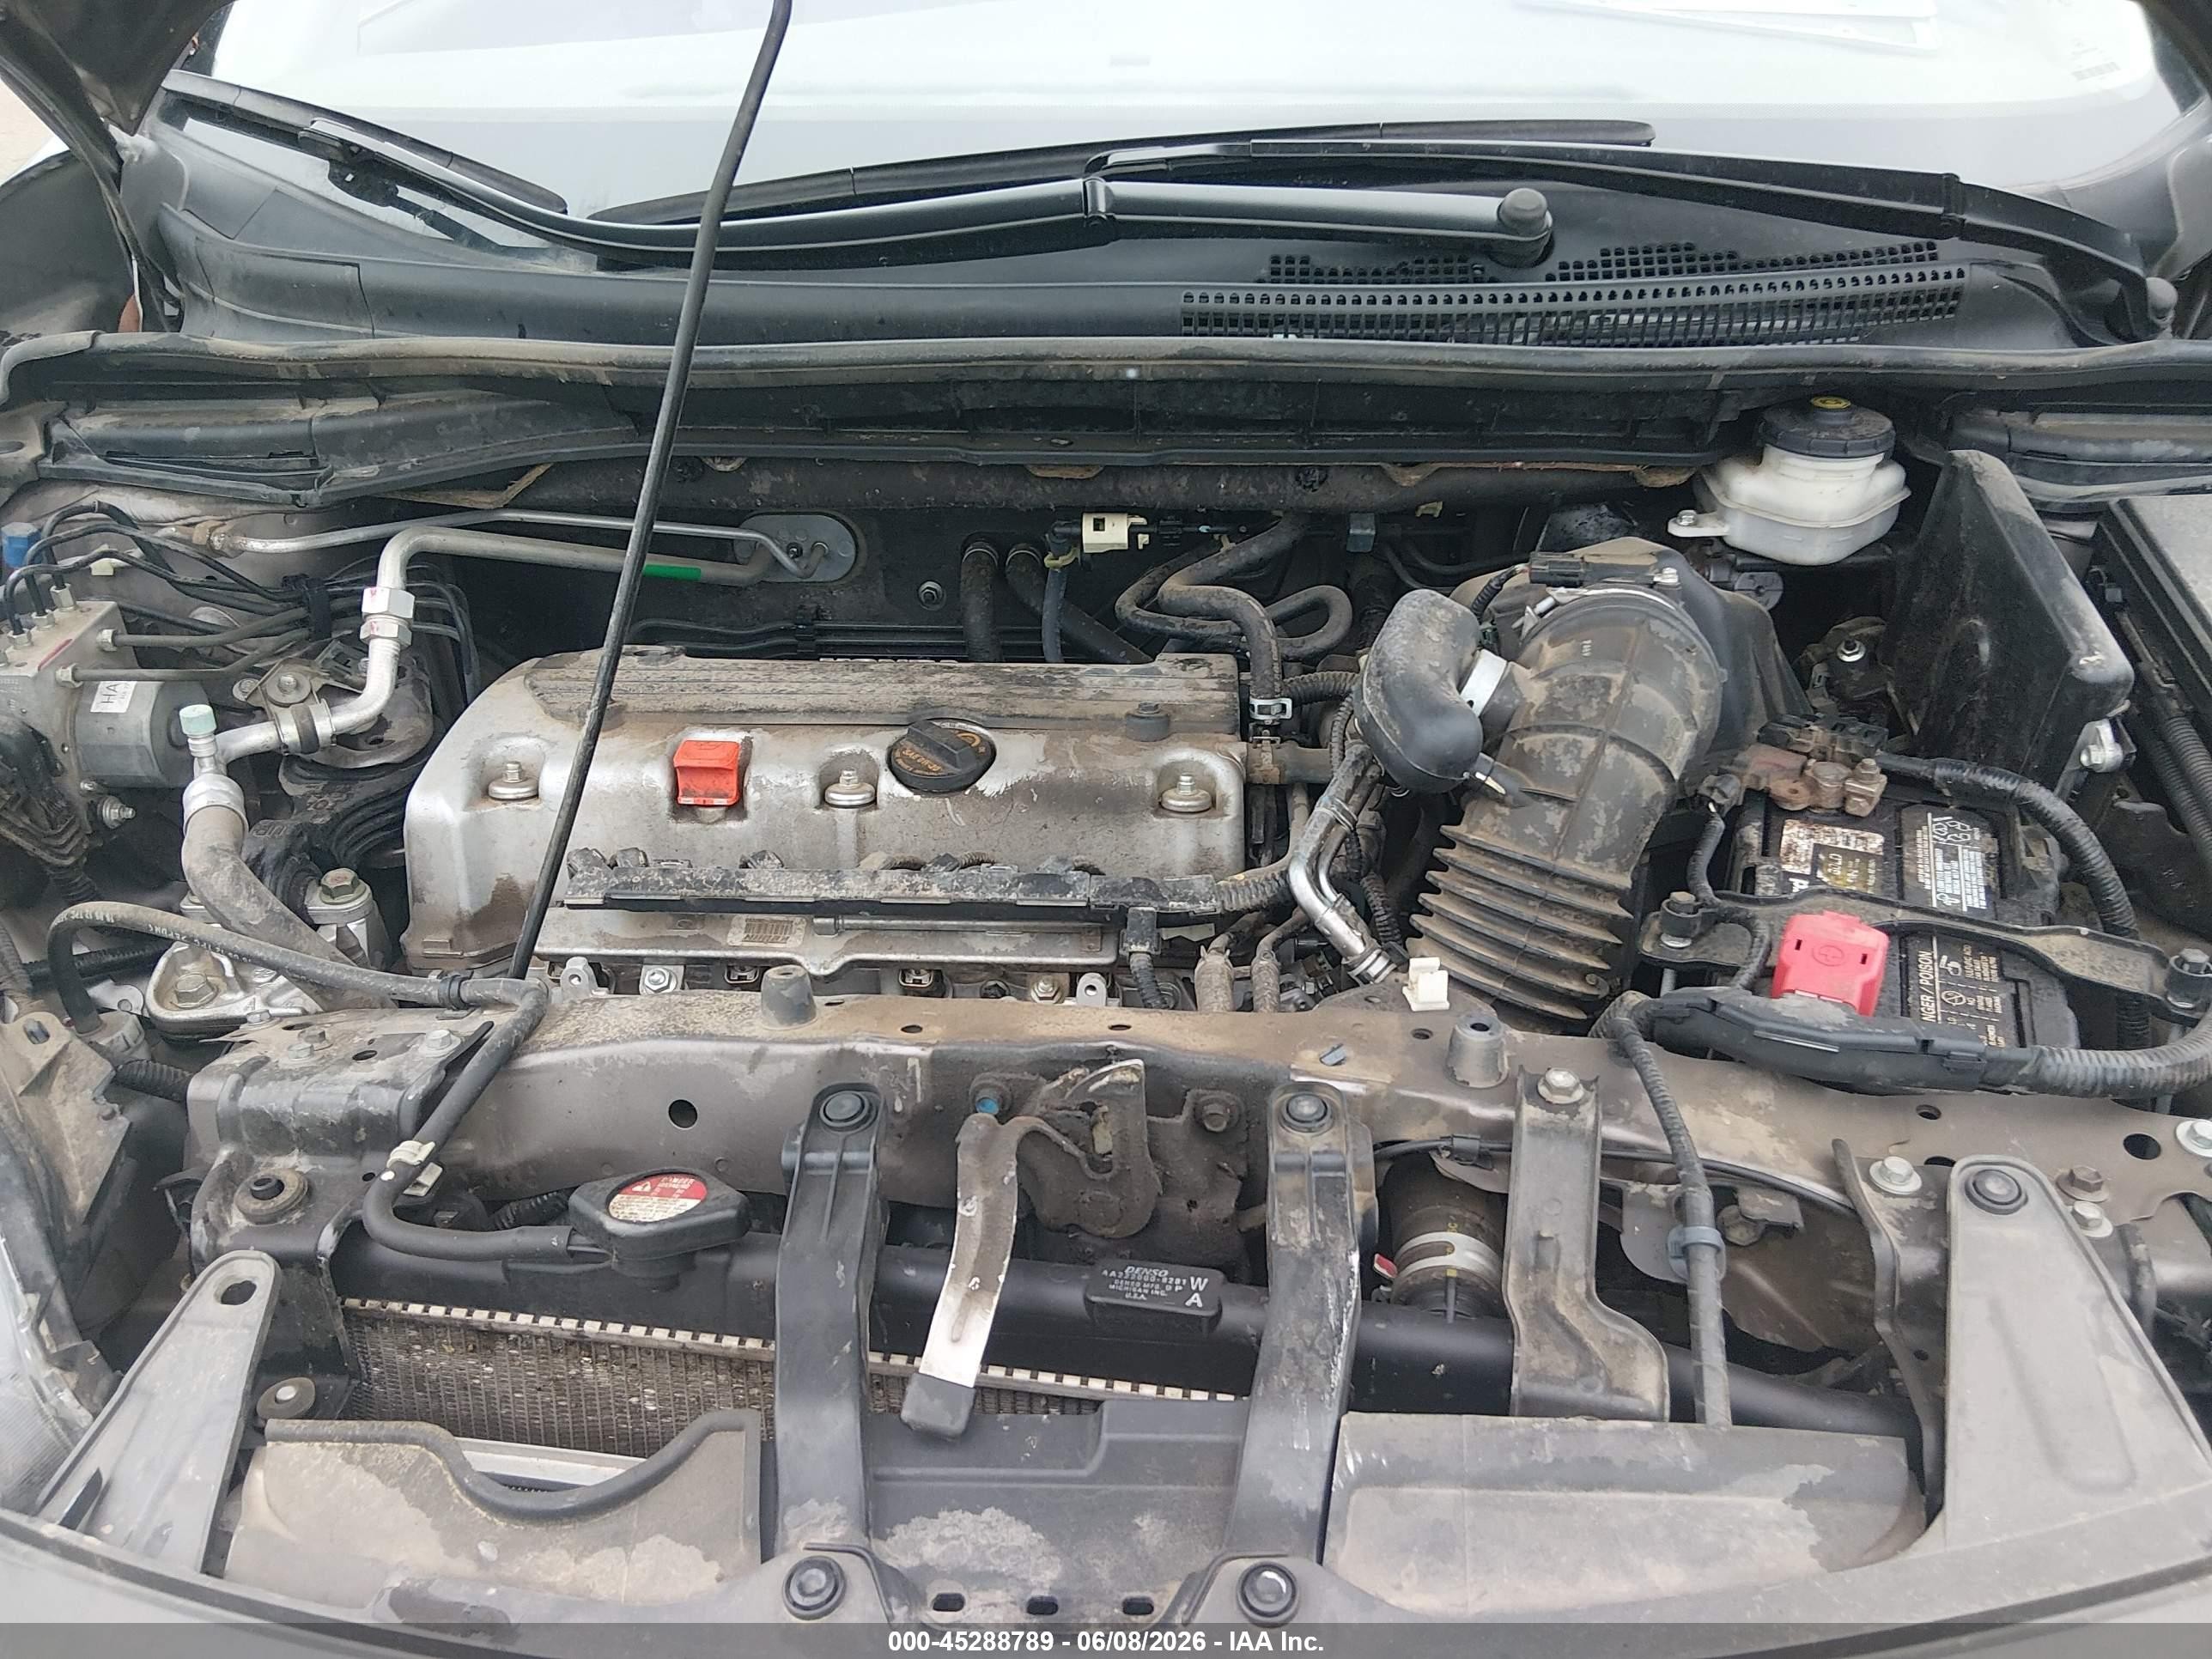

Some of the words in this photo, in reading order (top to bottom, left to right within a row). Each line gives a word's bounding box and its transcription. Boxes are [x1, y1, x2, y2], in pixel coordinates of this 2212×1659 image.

[1918, 950, 1935, 986] POISON
[1125, 1266, 1169, 1277] DENSO
[1189, 1276, 1209, 1291] W
[1185, 1292, 1203, 1308] A
